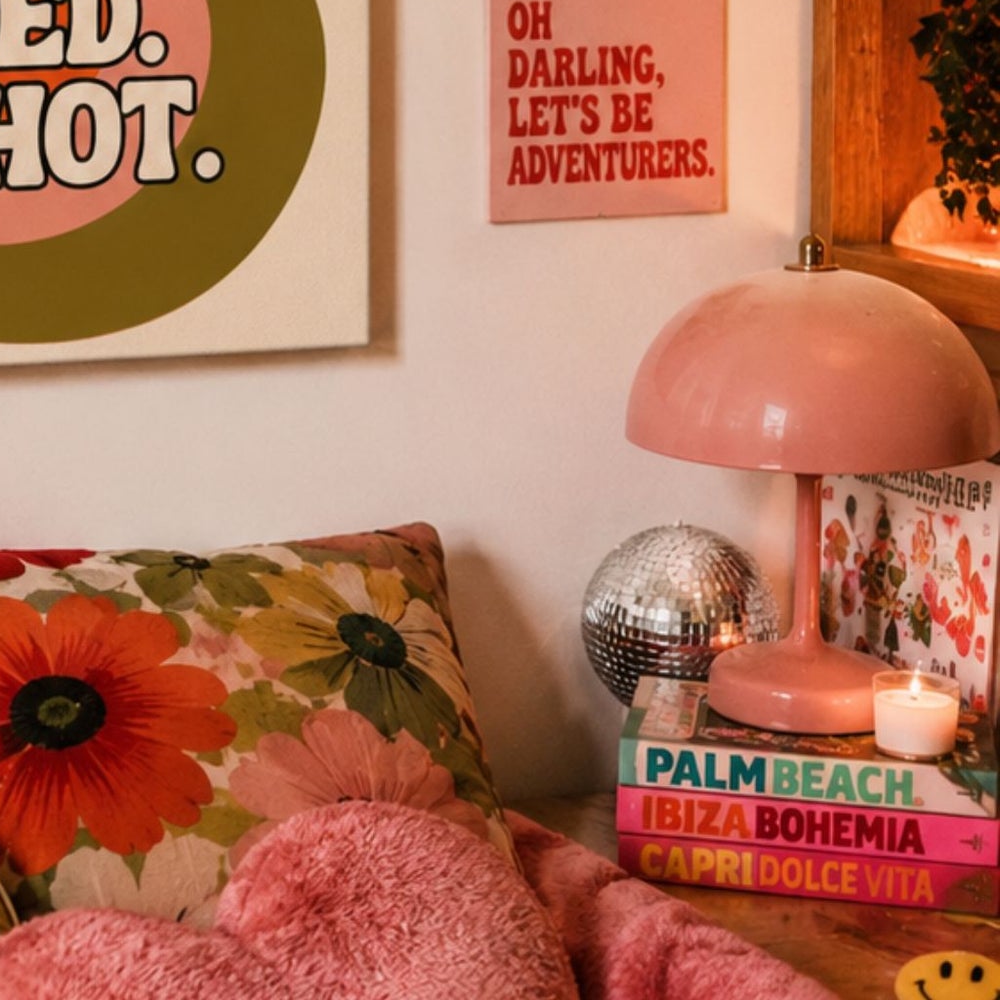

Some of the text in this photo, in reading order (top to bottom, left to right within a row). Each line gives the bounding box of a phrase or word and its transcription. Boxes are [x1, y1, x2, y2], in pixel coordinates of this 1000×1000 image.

[507, 1, 552, 41] OH
[507, 44, 665, 89] DARLING,
[508, 92, 653, 137] LET'S BE
[507, 138, 715, 186] ADVENTURERS.
[646, 747, 766, 793] PALM
[641, 795, 926, 855] IBIZA BOHEMIA
[639, 843, 935, 904] CAPRI DOLCE VITA
